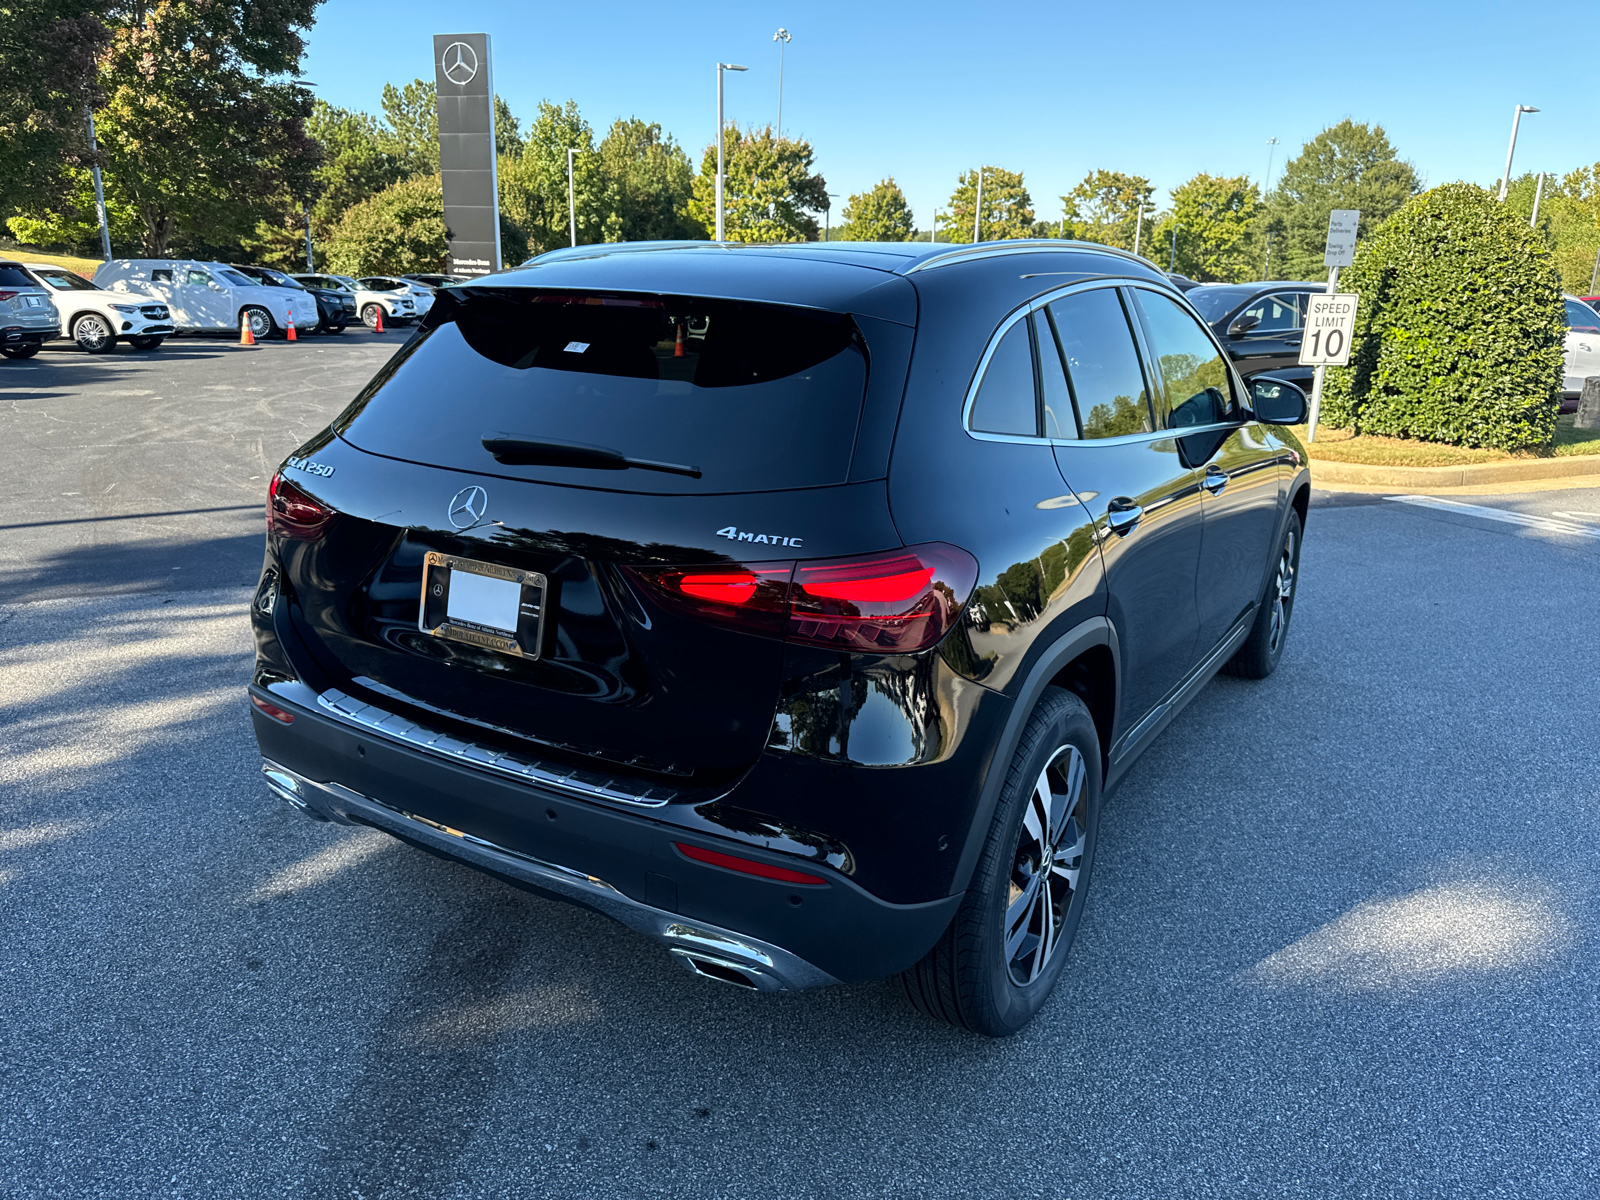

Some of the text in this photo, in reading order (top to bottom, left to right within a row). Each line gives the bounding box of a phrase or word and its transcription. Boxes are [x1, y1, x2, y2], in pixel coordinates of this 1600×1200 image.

[1314, 303, 1350, 314] SPEED
[1315, 316, 1346, 327] LIMIT
[1311, 329, 1344, 357] 10
[305, 462, 335, 478] 250
[716, 526, 803, 548] 4MATIC
